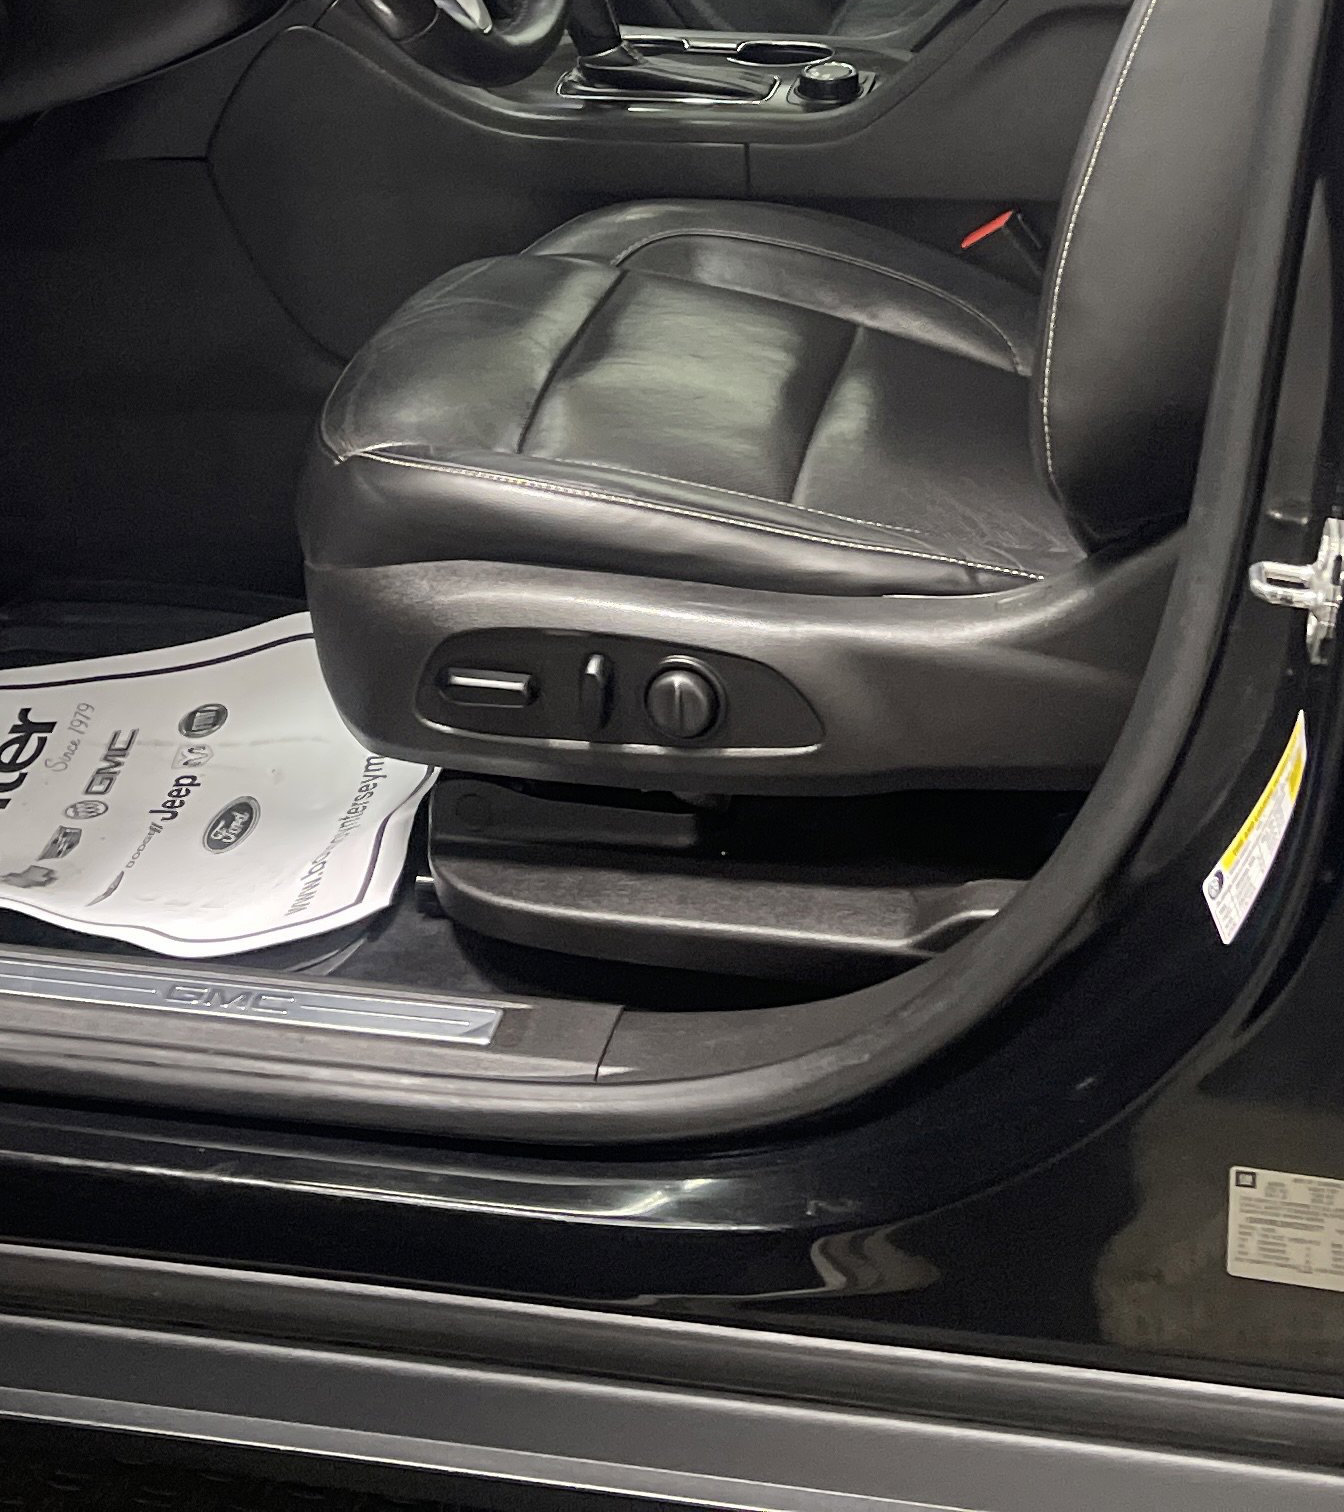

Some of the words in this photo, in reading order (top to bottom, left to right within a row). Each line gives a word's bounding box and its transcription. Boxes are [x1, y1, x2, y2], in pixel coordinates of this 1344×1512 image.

[45, 737, 81, 772] Since
[67, 702, 95, 735] 1979
[83, 727, 140, 795] GMC
[149, 774, 201, 822] Jeep
[210, 810, 250, 844] Ford
[165, 984, 296, 1015] GMC
